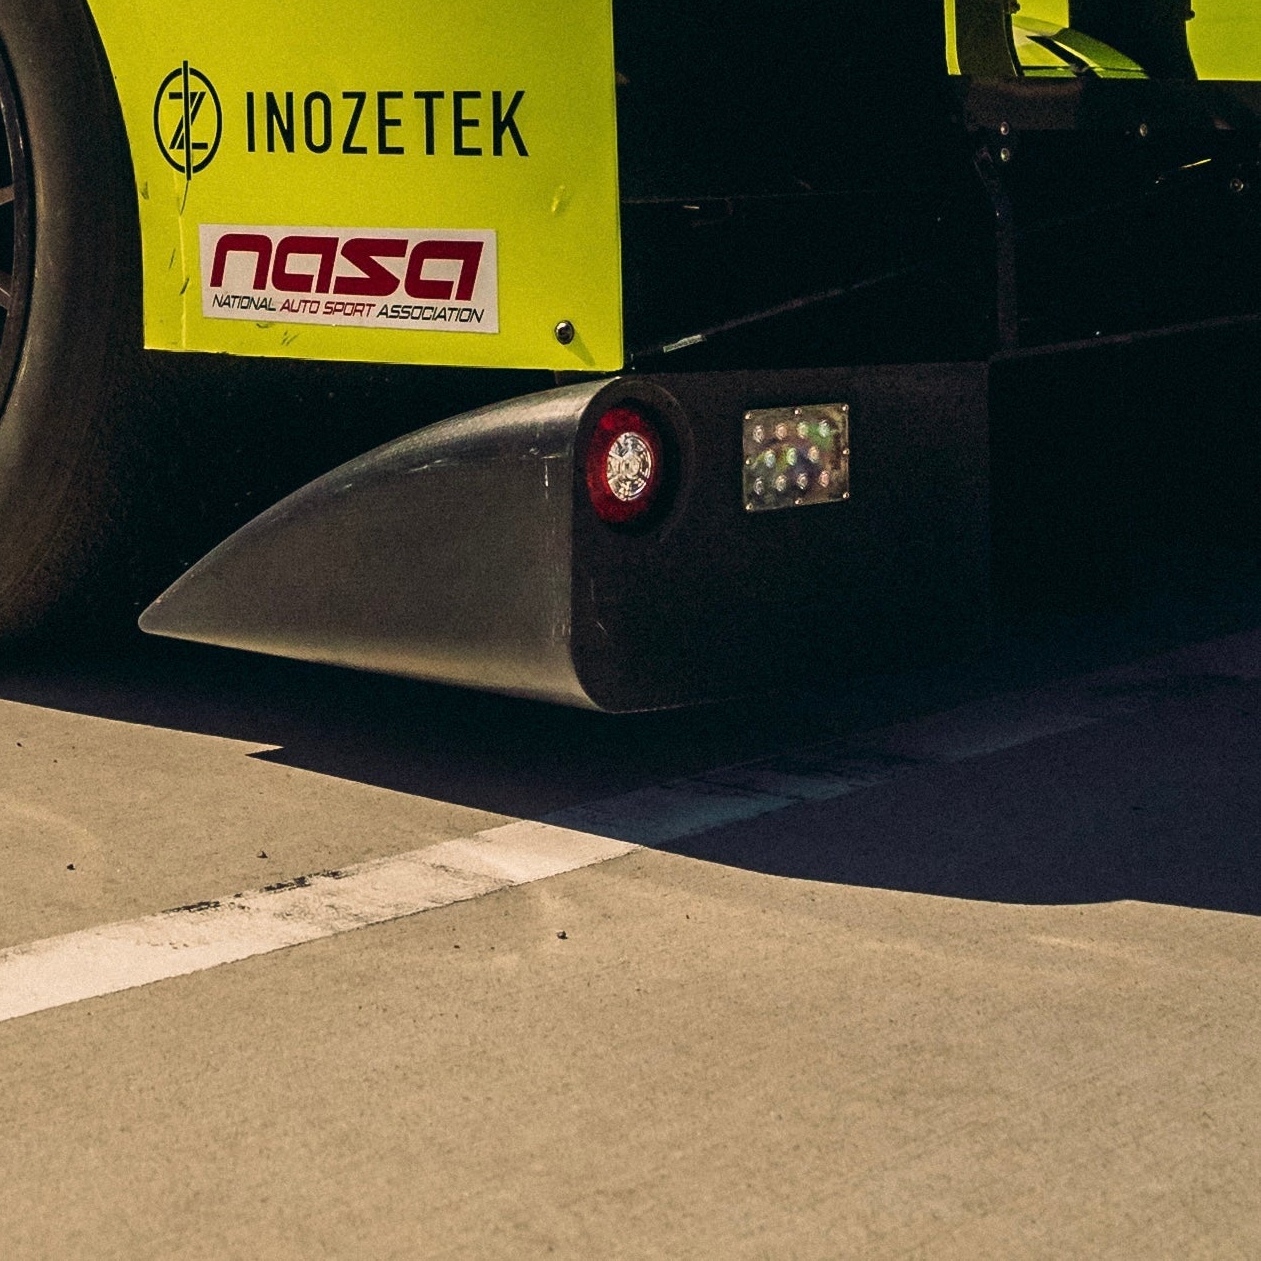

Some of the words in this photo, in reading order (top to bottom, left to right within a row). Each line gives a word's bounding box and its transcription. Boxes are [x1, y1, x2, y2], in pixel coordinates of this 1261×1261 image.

[246, 90, 530, 157] INOZETEK
[212, 293, 276, 312] NATIONAL
[279, 298, 320, 315] AUTO
[322, 300, 377, 318] SPORT
[376, 303, 485, 324] ASSOCIATION
